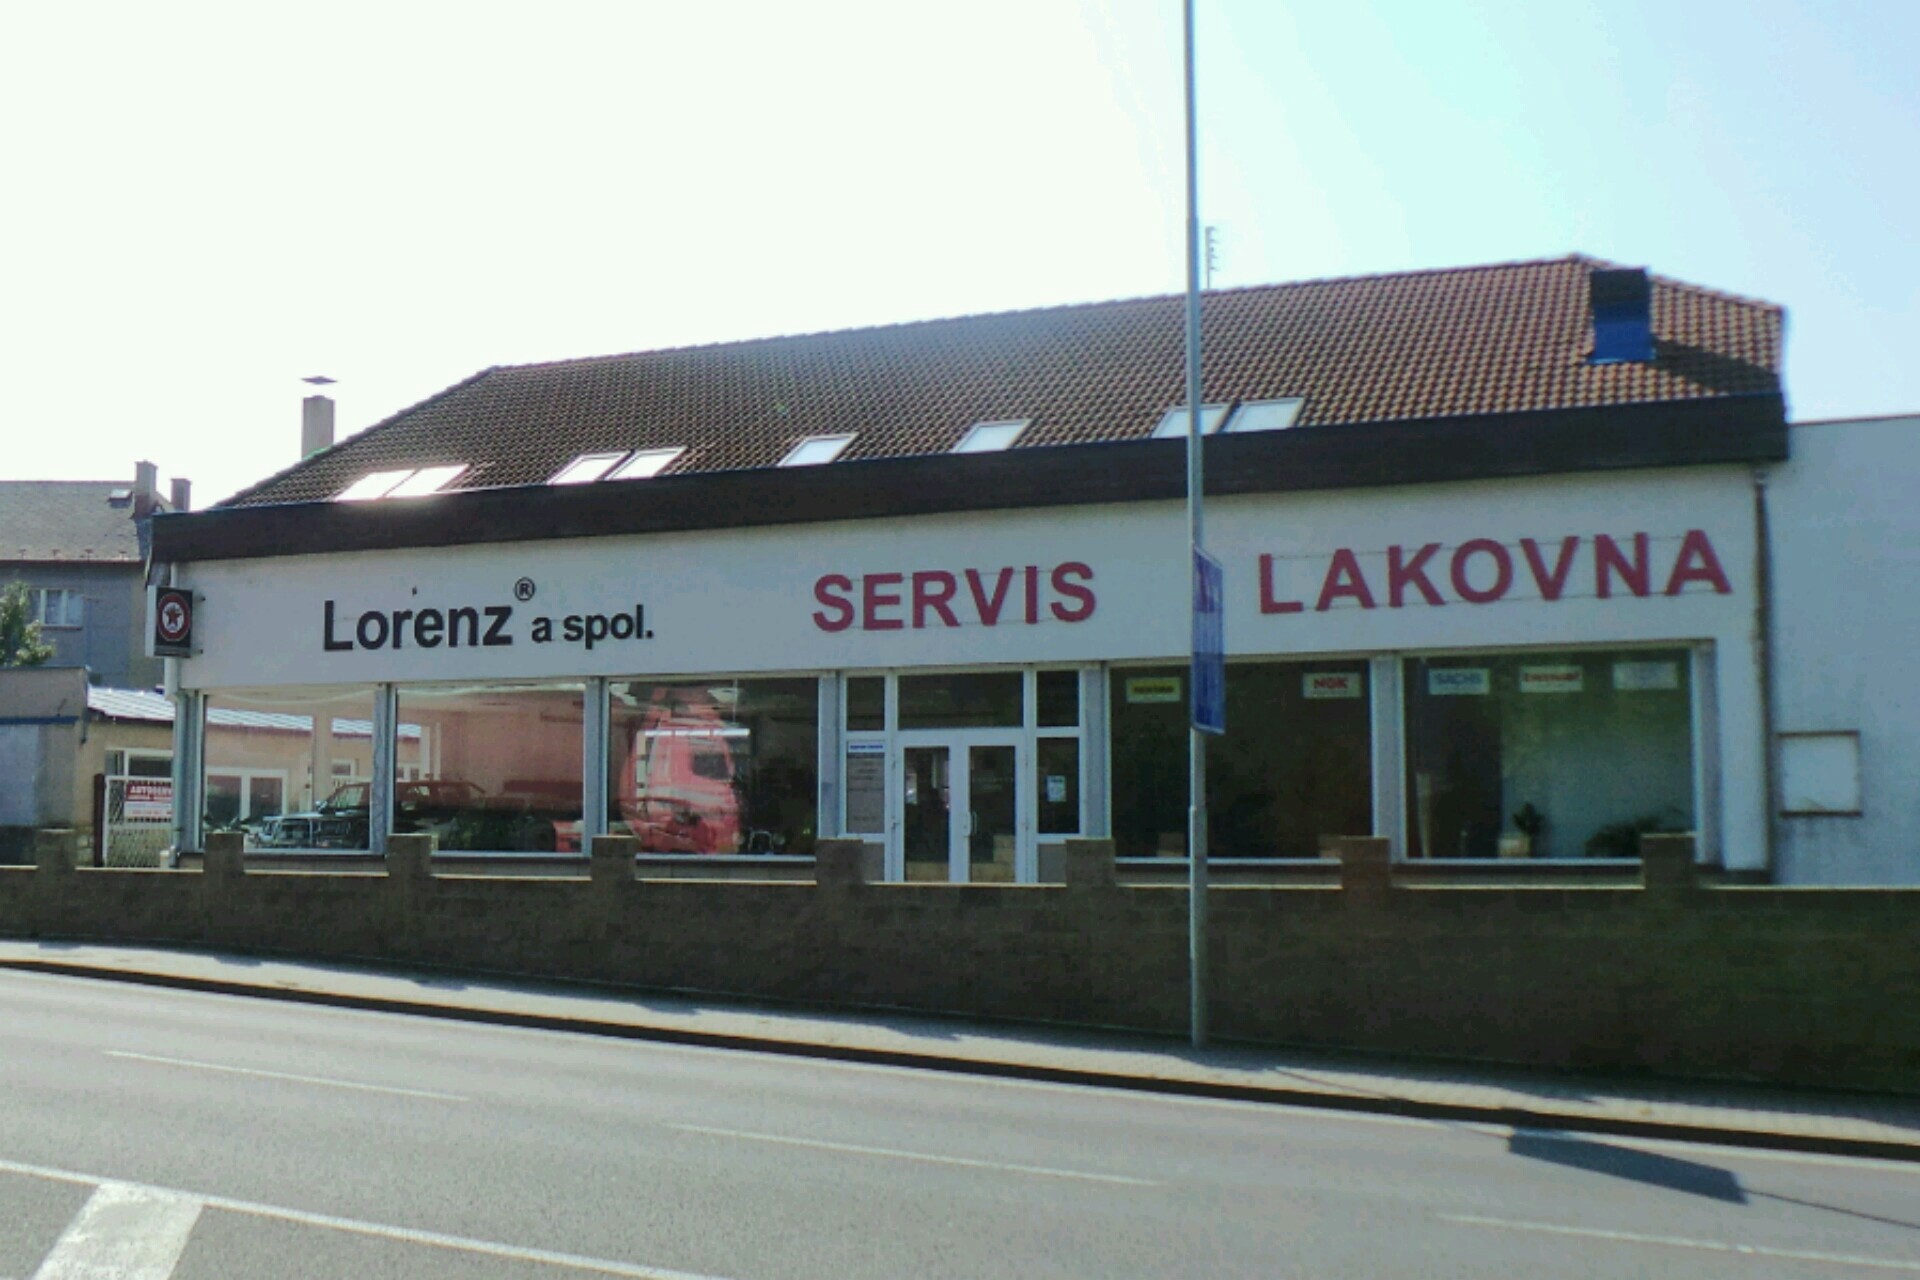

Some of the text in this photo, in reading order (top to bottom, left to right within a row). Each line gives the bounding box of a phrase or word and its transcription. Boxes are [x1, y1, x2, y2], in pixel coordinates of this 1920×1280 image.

[813, 561, 1096, 632] SERVIS
[1261, 529, 1731, 613] LAKOVNA
[532, 615, 553, 644] a
[563, 604, 654, 650] spol.
